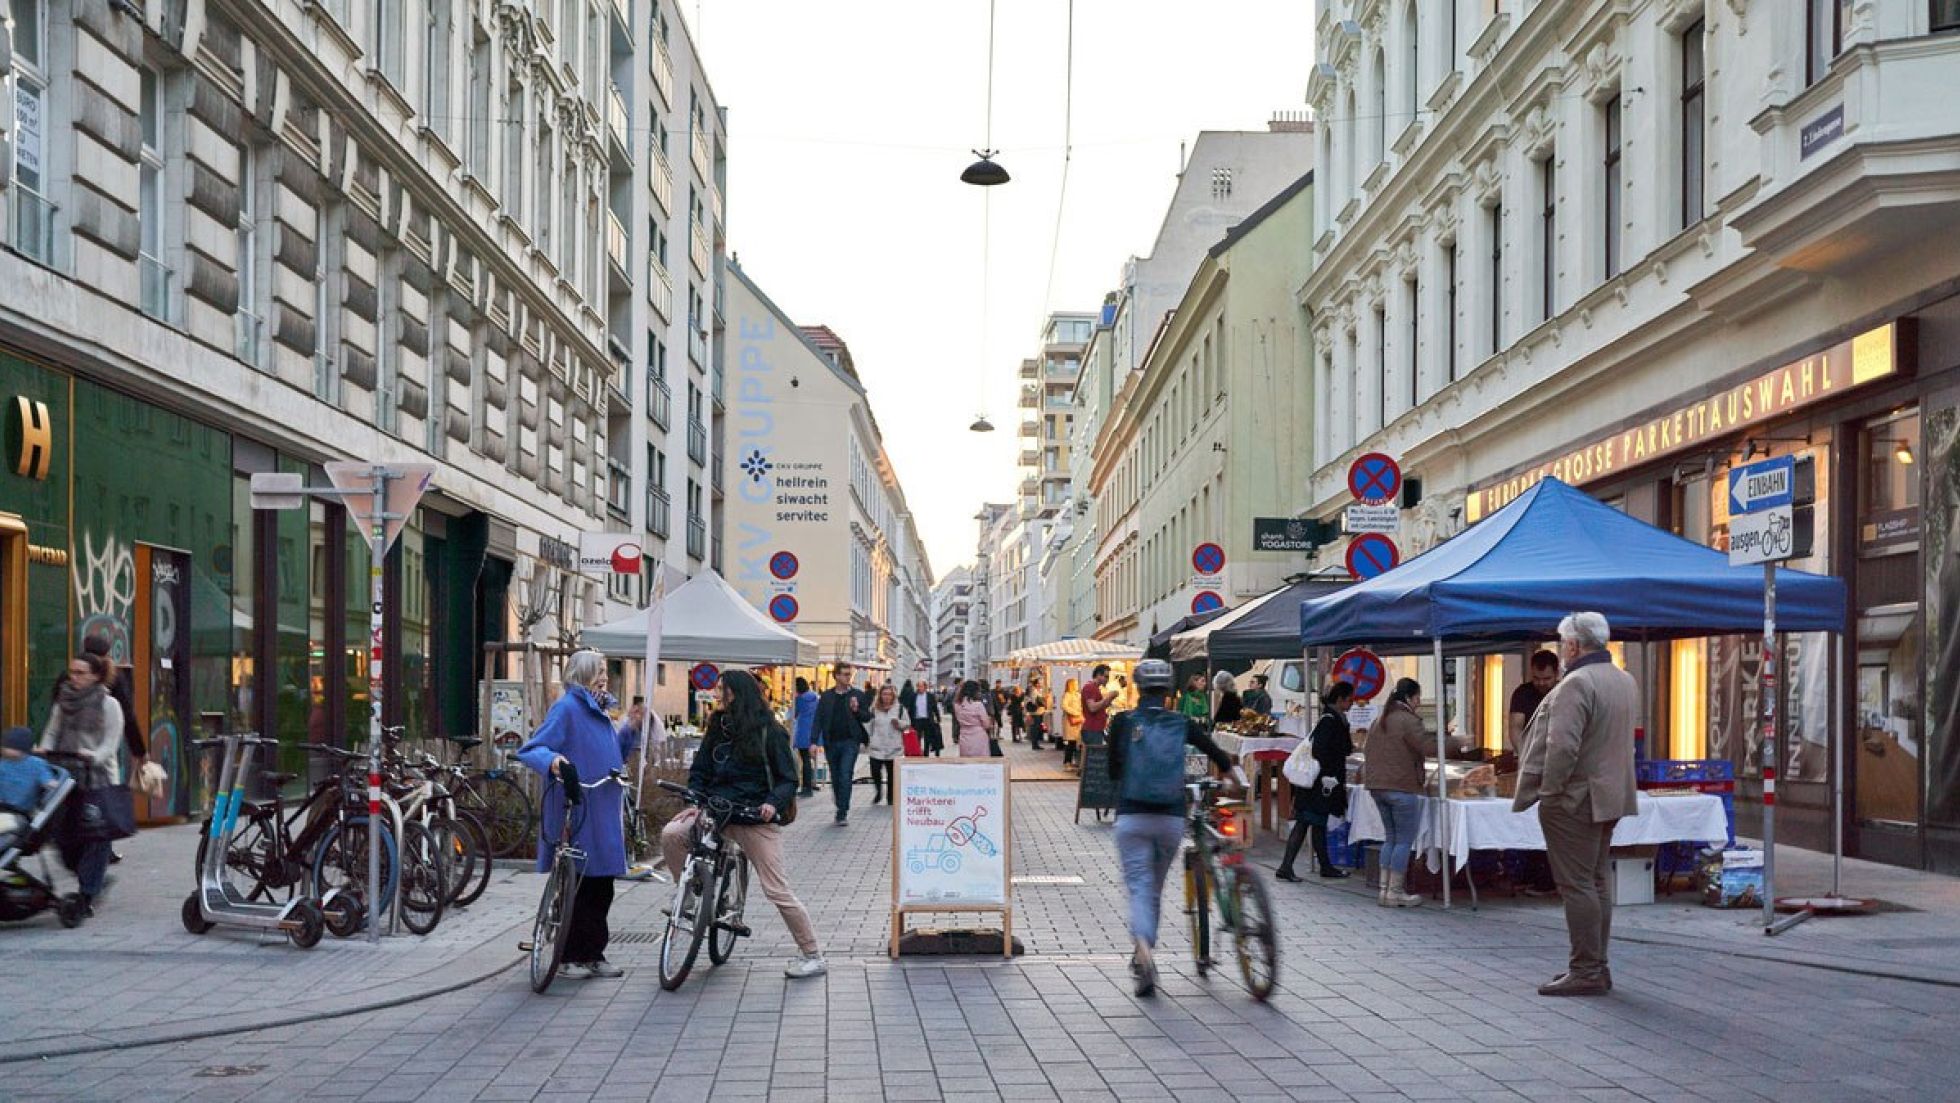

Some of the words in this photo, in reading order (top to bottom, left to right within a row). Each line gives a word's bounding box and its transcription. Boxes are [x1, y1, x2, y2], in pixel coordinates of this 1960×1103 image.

[1553, 441, 1613, 484] GROSSE
[1623, 354, 1832, 463] PARKETTAUSWAHL
[16, 395, 52, 481] H
[776, 476, 828, 488] hellrein
[1748, 471, 1787, 498] EINBAHN
[776, 493, 829, 505] siwacht
[776, 510, 829, 521] servitec
[1261, 541, 1313, 549] YOGASTORE
[929, 786, 997, 796] Neubaumarkt
[906, 796, 956, 806] Markterei
[906, 806, 933, 816] trifft
[906, 817, 945, 826] Neubau
